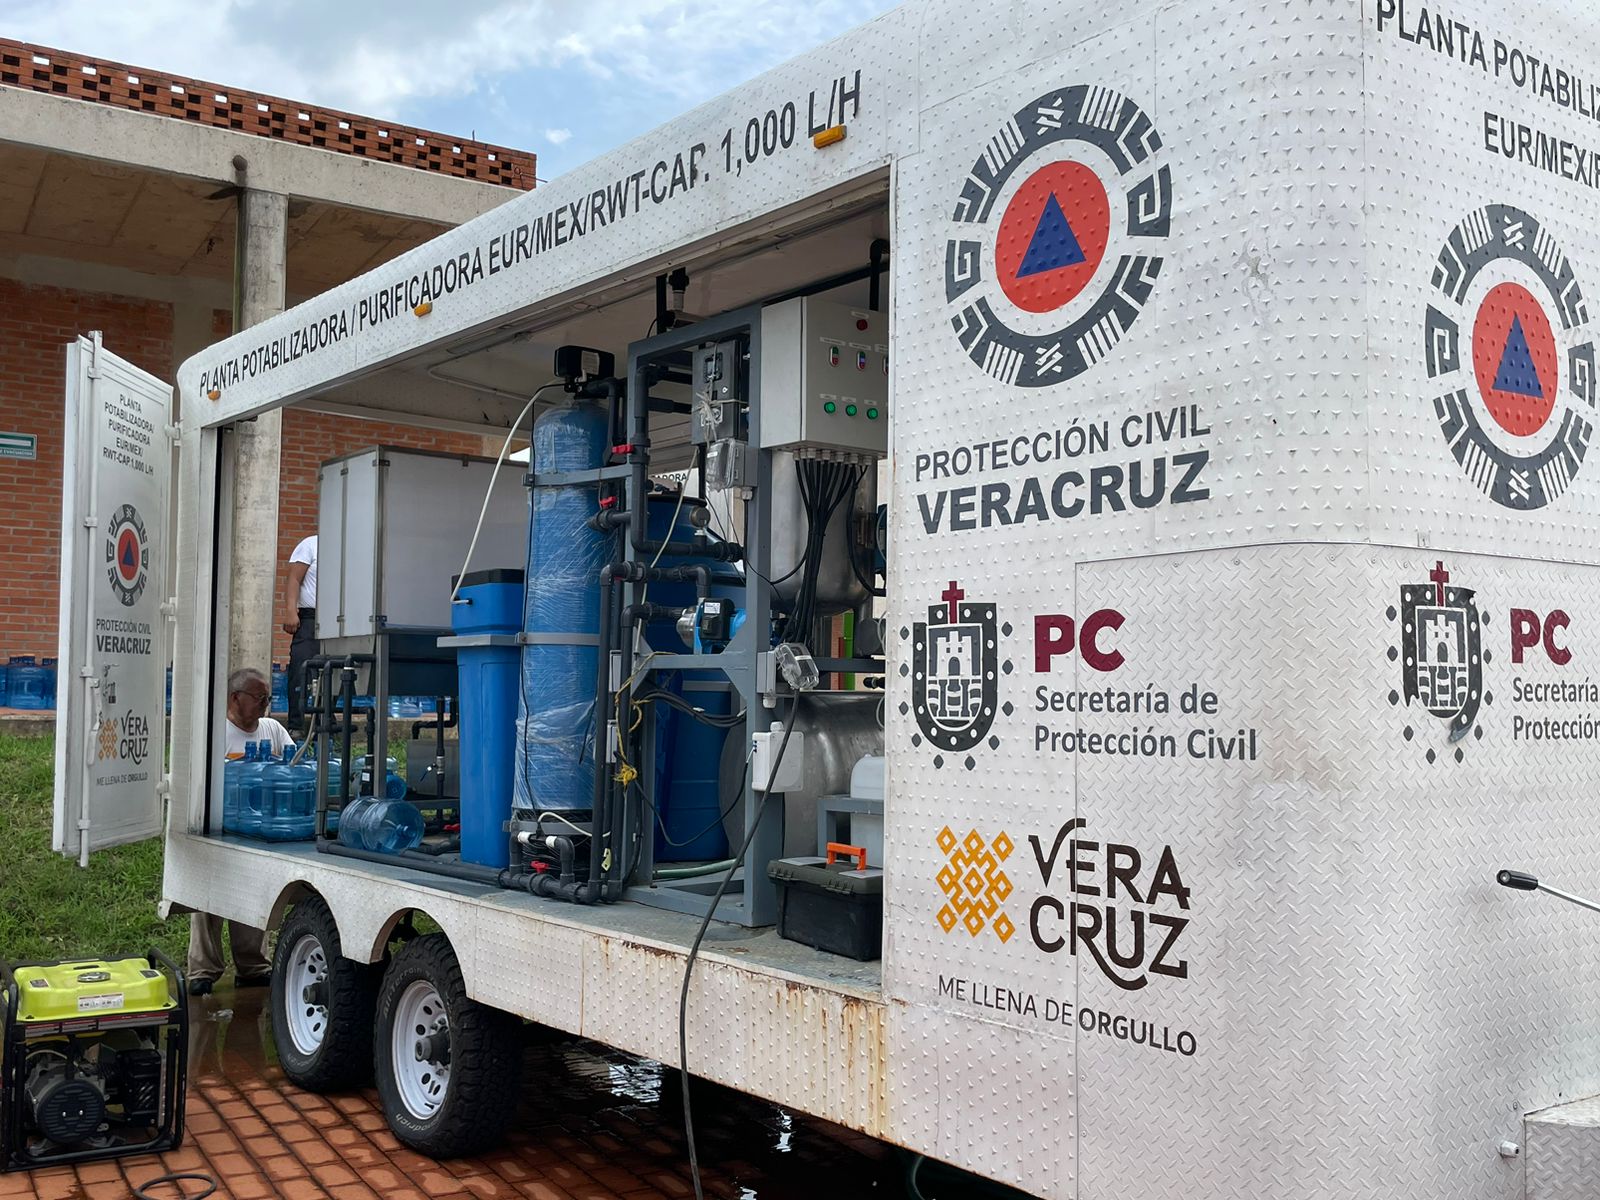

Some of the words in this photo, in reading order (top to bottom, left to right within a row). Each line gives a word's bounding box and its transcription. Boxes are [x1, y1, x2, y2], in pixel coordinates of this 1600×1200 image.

[1377, 0, 1488, 72] PLANTA
[199, 355, 240, 397] PLANTA
[242, 310, 349, 379] POTABILIZADORA
[351, 304, 357, 336] /
[359, 247, 484, 332] PURIFICADORA
[488, 142, 710, 275] EUR/MEX/RWT-CAP.
[720, 100, 797, 178] 1,000
[807, 69, 863, 139] L/H
[108, 418, 151, 447] PURIFICADORA
[119, 393, 143, 414] PLANTA
[915, 417, 1109, 482] PROTECCIÓN
[1120, 403, 1211, 448] CIVIL
[916, 449, 1211, 535] VERACRUZ
[96, 635, 151, 655] VERACRUZ
[1034, 607, 1127, 673] PC
[1510, 607, 1573, 666] PC
[1034, 682, 1170, 714] Secretaría
[1179, 682, 1219, 715] de
[1513, 676, 1599, 703] Secretaría
[120, 738, 149, 765] CRUZ
[121, 708, 149, 737] VERA
[1034, 724, 1177, 758] Protección
[1187, 727, 1257, 761] Civil
[1028, 817, 1191, 910] VERA
[1029, 895, 1191, 991] CRUZ
[938, 974, 966, 1002] ME
[972, 982, 1038, 1019] LLENA
[1045, 998, 1074, 1027] DE
[1079, 1007, 1197, 1057] ORGULLO
